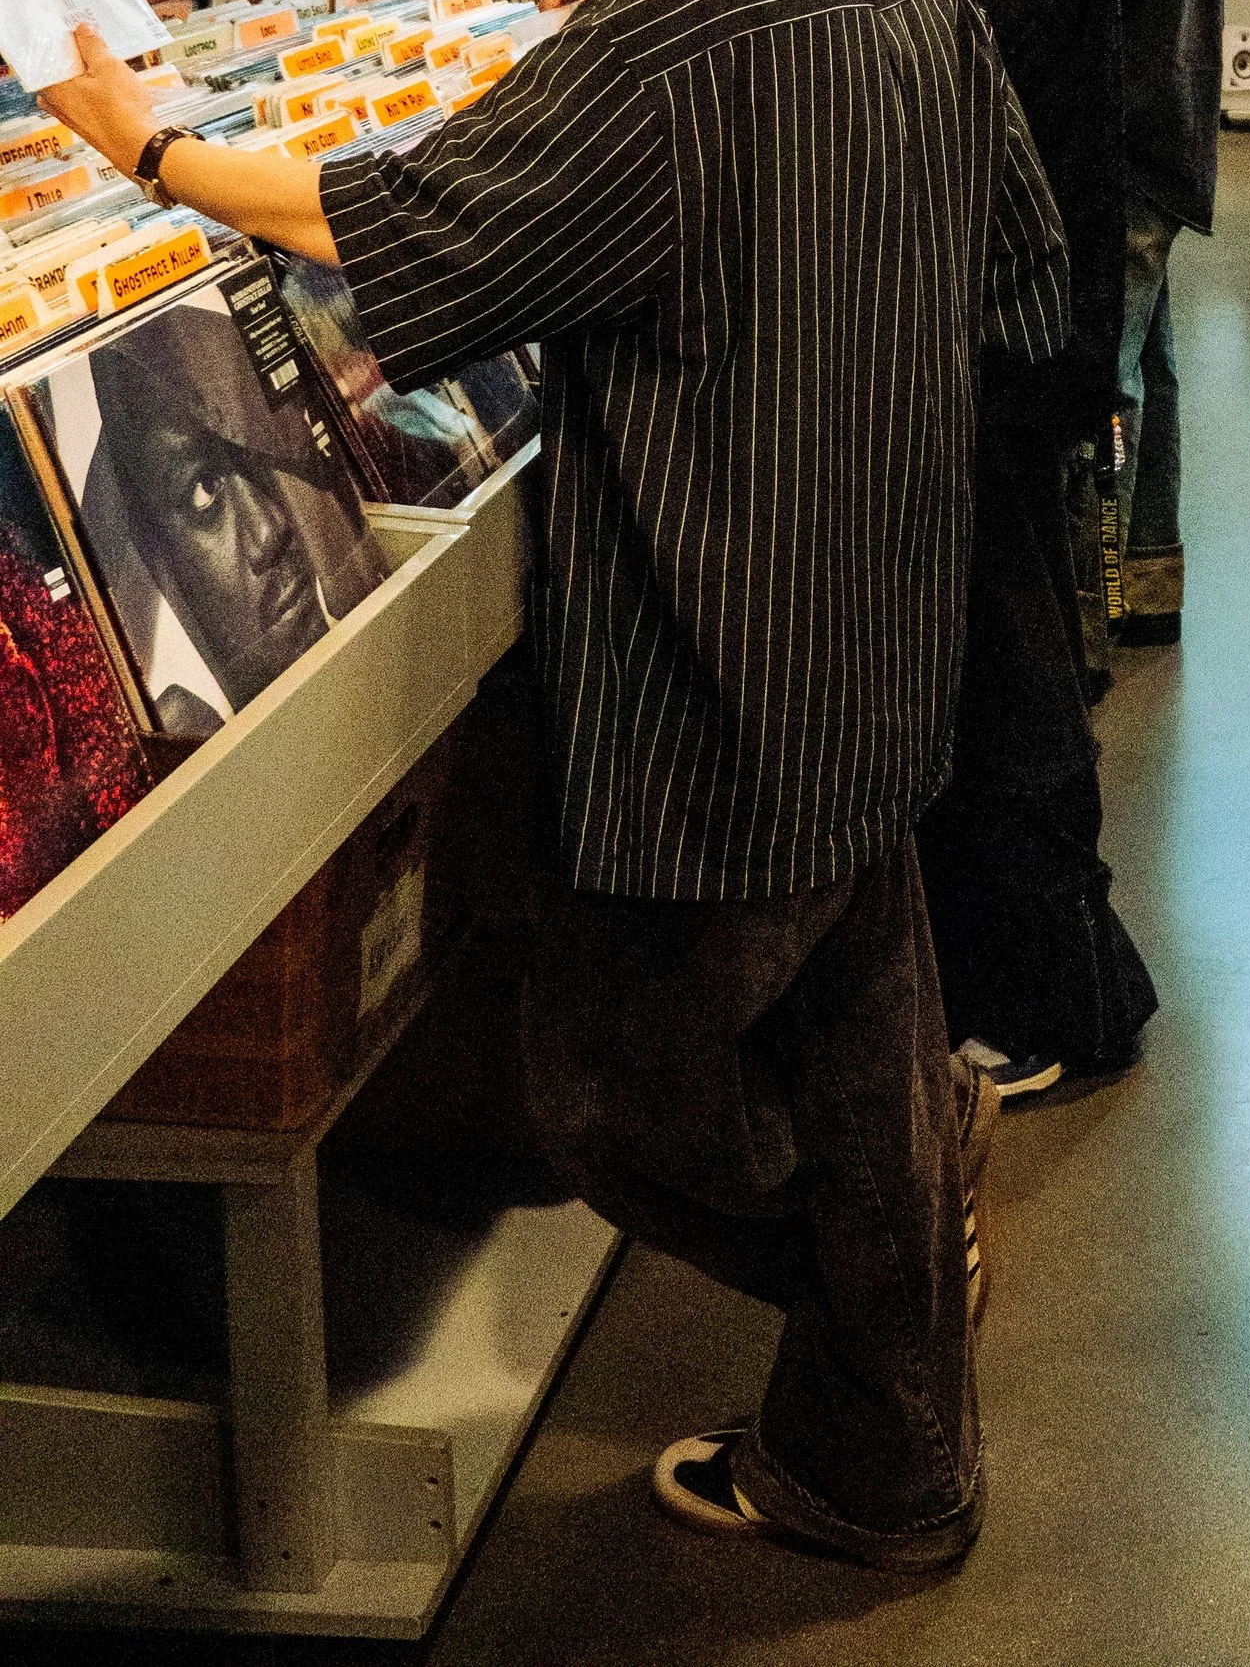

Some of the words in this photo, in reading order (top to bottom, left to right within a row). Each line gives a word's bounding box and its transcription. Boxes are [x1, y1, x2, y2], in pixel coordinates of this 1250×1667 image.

[384, 103, 401, 117] KID
[303, 137, 319, 156] KID
[113, 259, 168, 298] GHOSTFACE
[170, 243, 202, 271] KILLAH
[1101, 498, 1118, 543] DANCE
[1103, 547, 1119, 564] OF
[1105, 567, 1123, 619] WORLD
